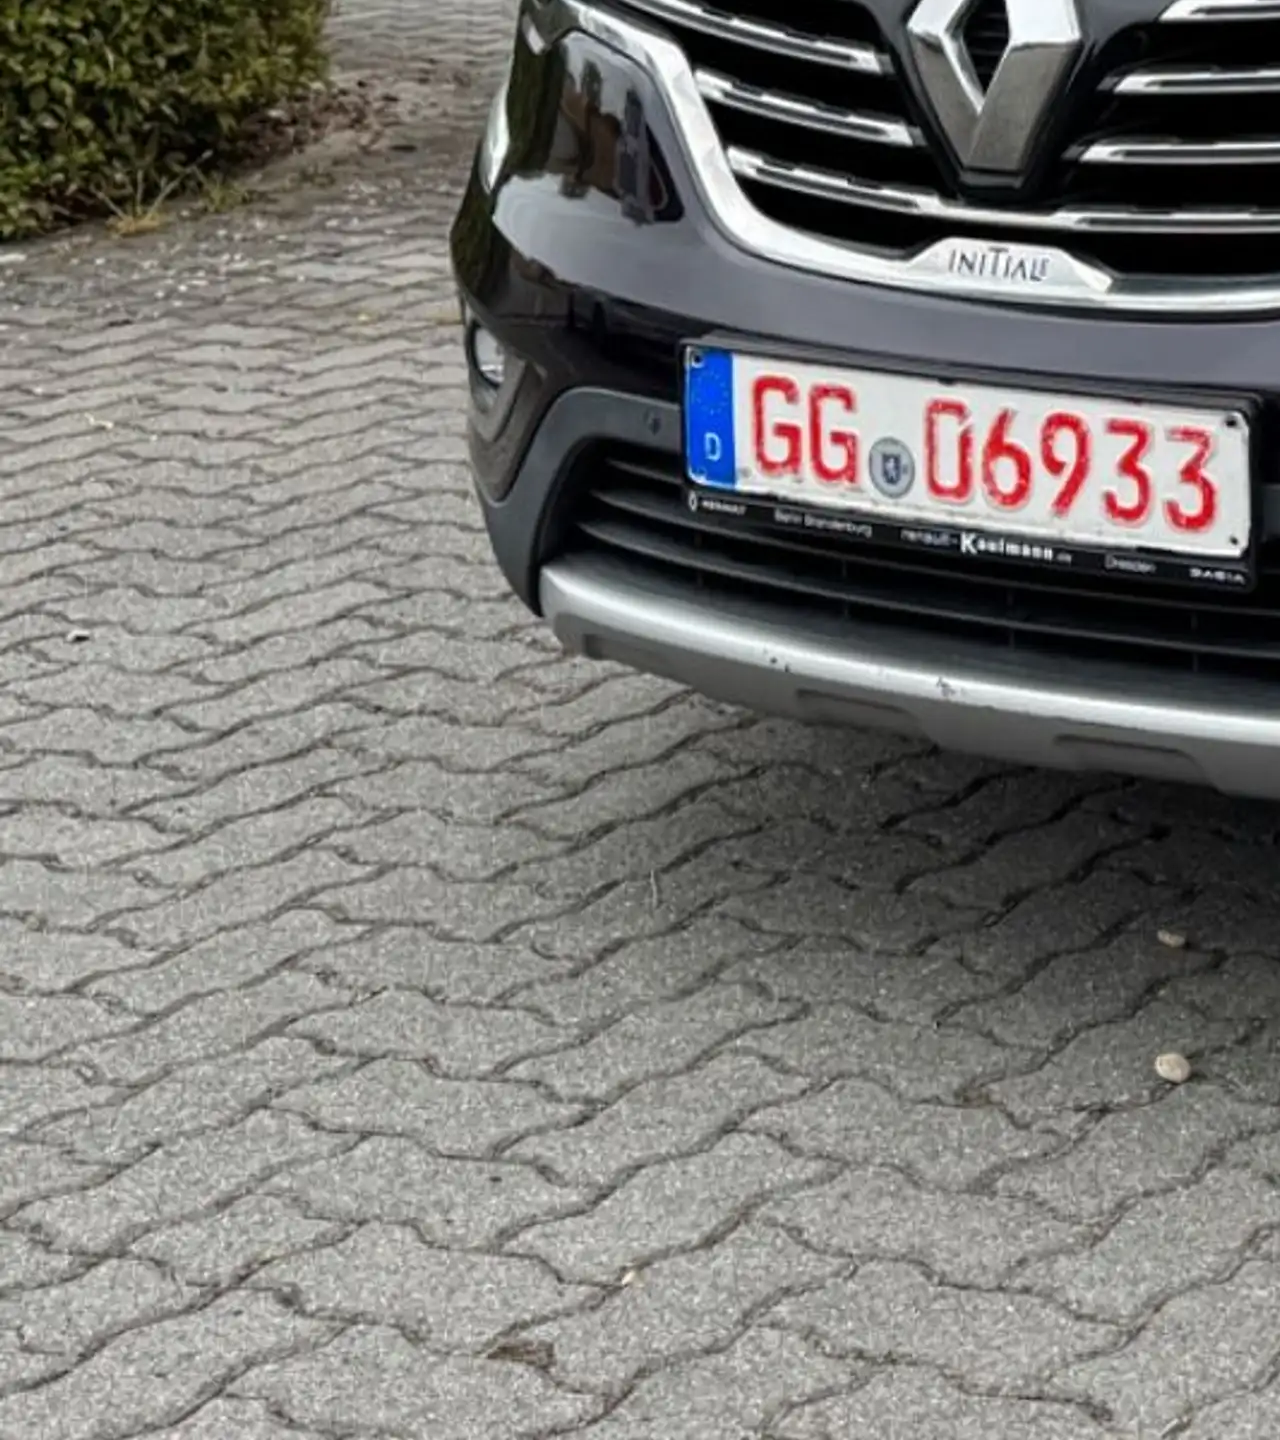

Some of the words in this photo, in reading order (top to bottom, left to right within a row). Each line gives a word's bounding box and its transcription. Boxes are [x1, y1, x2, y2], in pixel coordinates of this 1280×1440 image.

[704, 432, 722, 462] D
[751, 374, 861, 486] GG
[924, 397, 1217, 532] 06933
